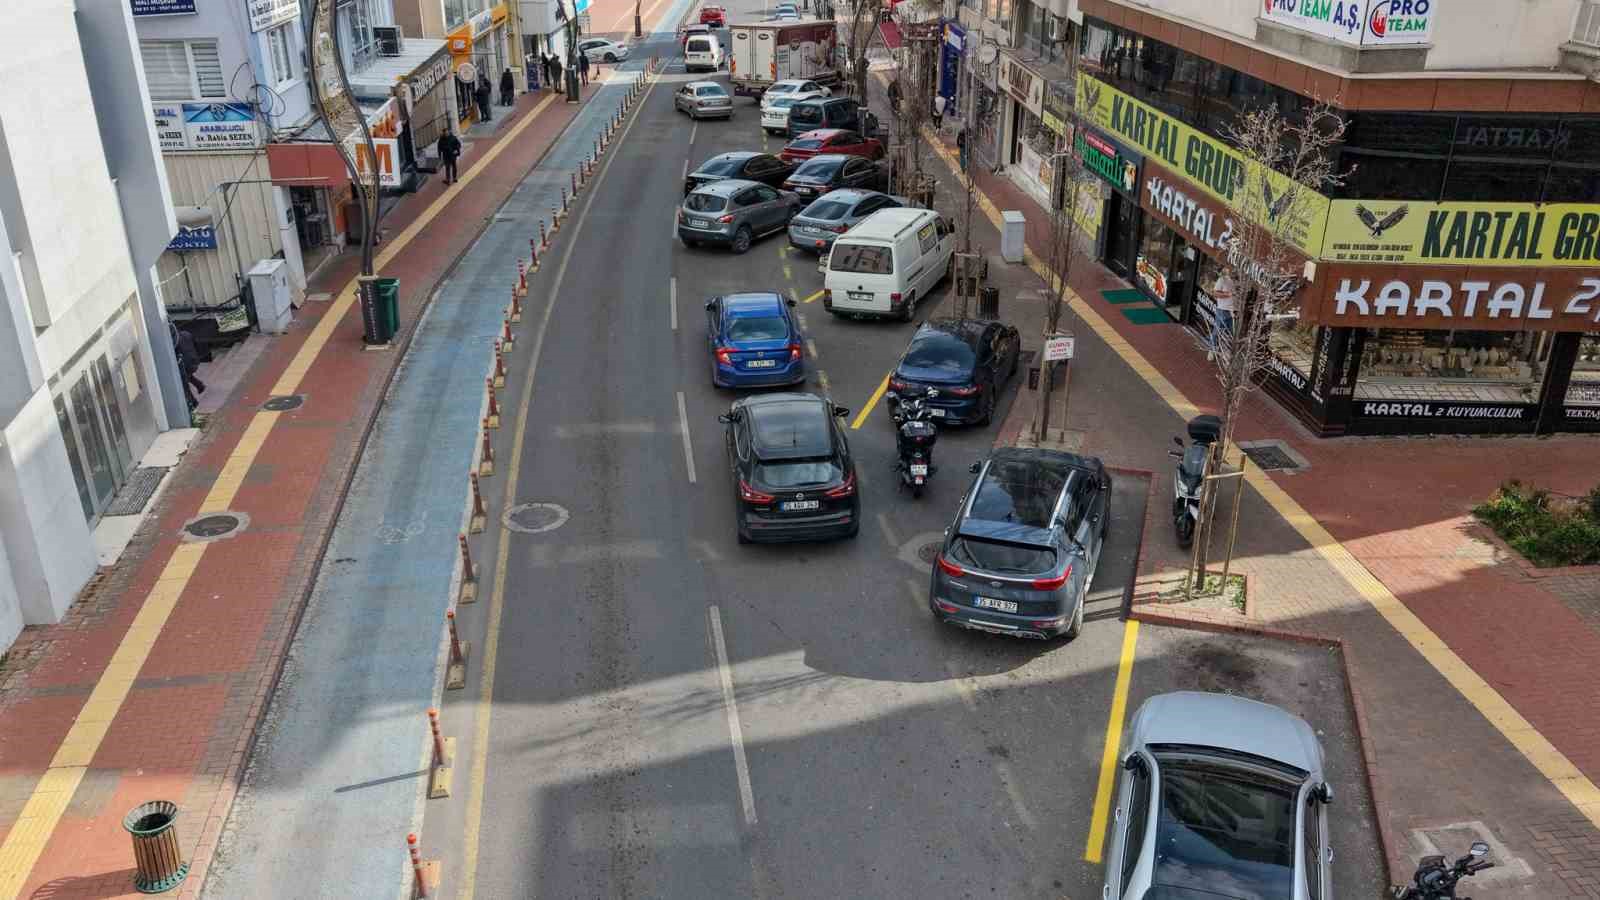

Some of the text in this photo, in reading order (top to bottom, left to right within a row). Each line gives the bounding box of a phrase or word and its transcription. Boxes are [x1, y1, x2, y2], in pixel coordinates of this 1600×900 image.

[1299, 0, 1331, 22] TEAM
[1389, 0, 1430, 15] PRO
[1388, 18, 1428, 32] TEAM
[229, 133, 253, 141] SEZEN
[1111, 94, 1179, 167] KARTAL
[1147, 176, 1217, 249] KARTAL
[1216, 217, 1233, 250] 2
[1421, 210, 1546, 260] KARTAL
[1335, 279, 1553, 319] KARTAL
[1564, 279, 1600, 313] 2
[1364, 403, 1524, 418] KARTAL 2 KUYUMCULUK
